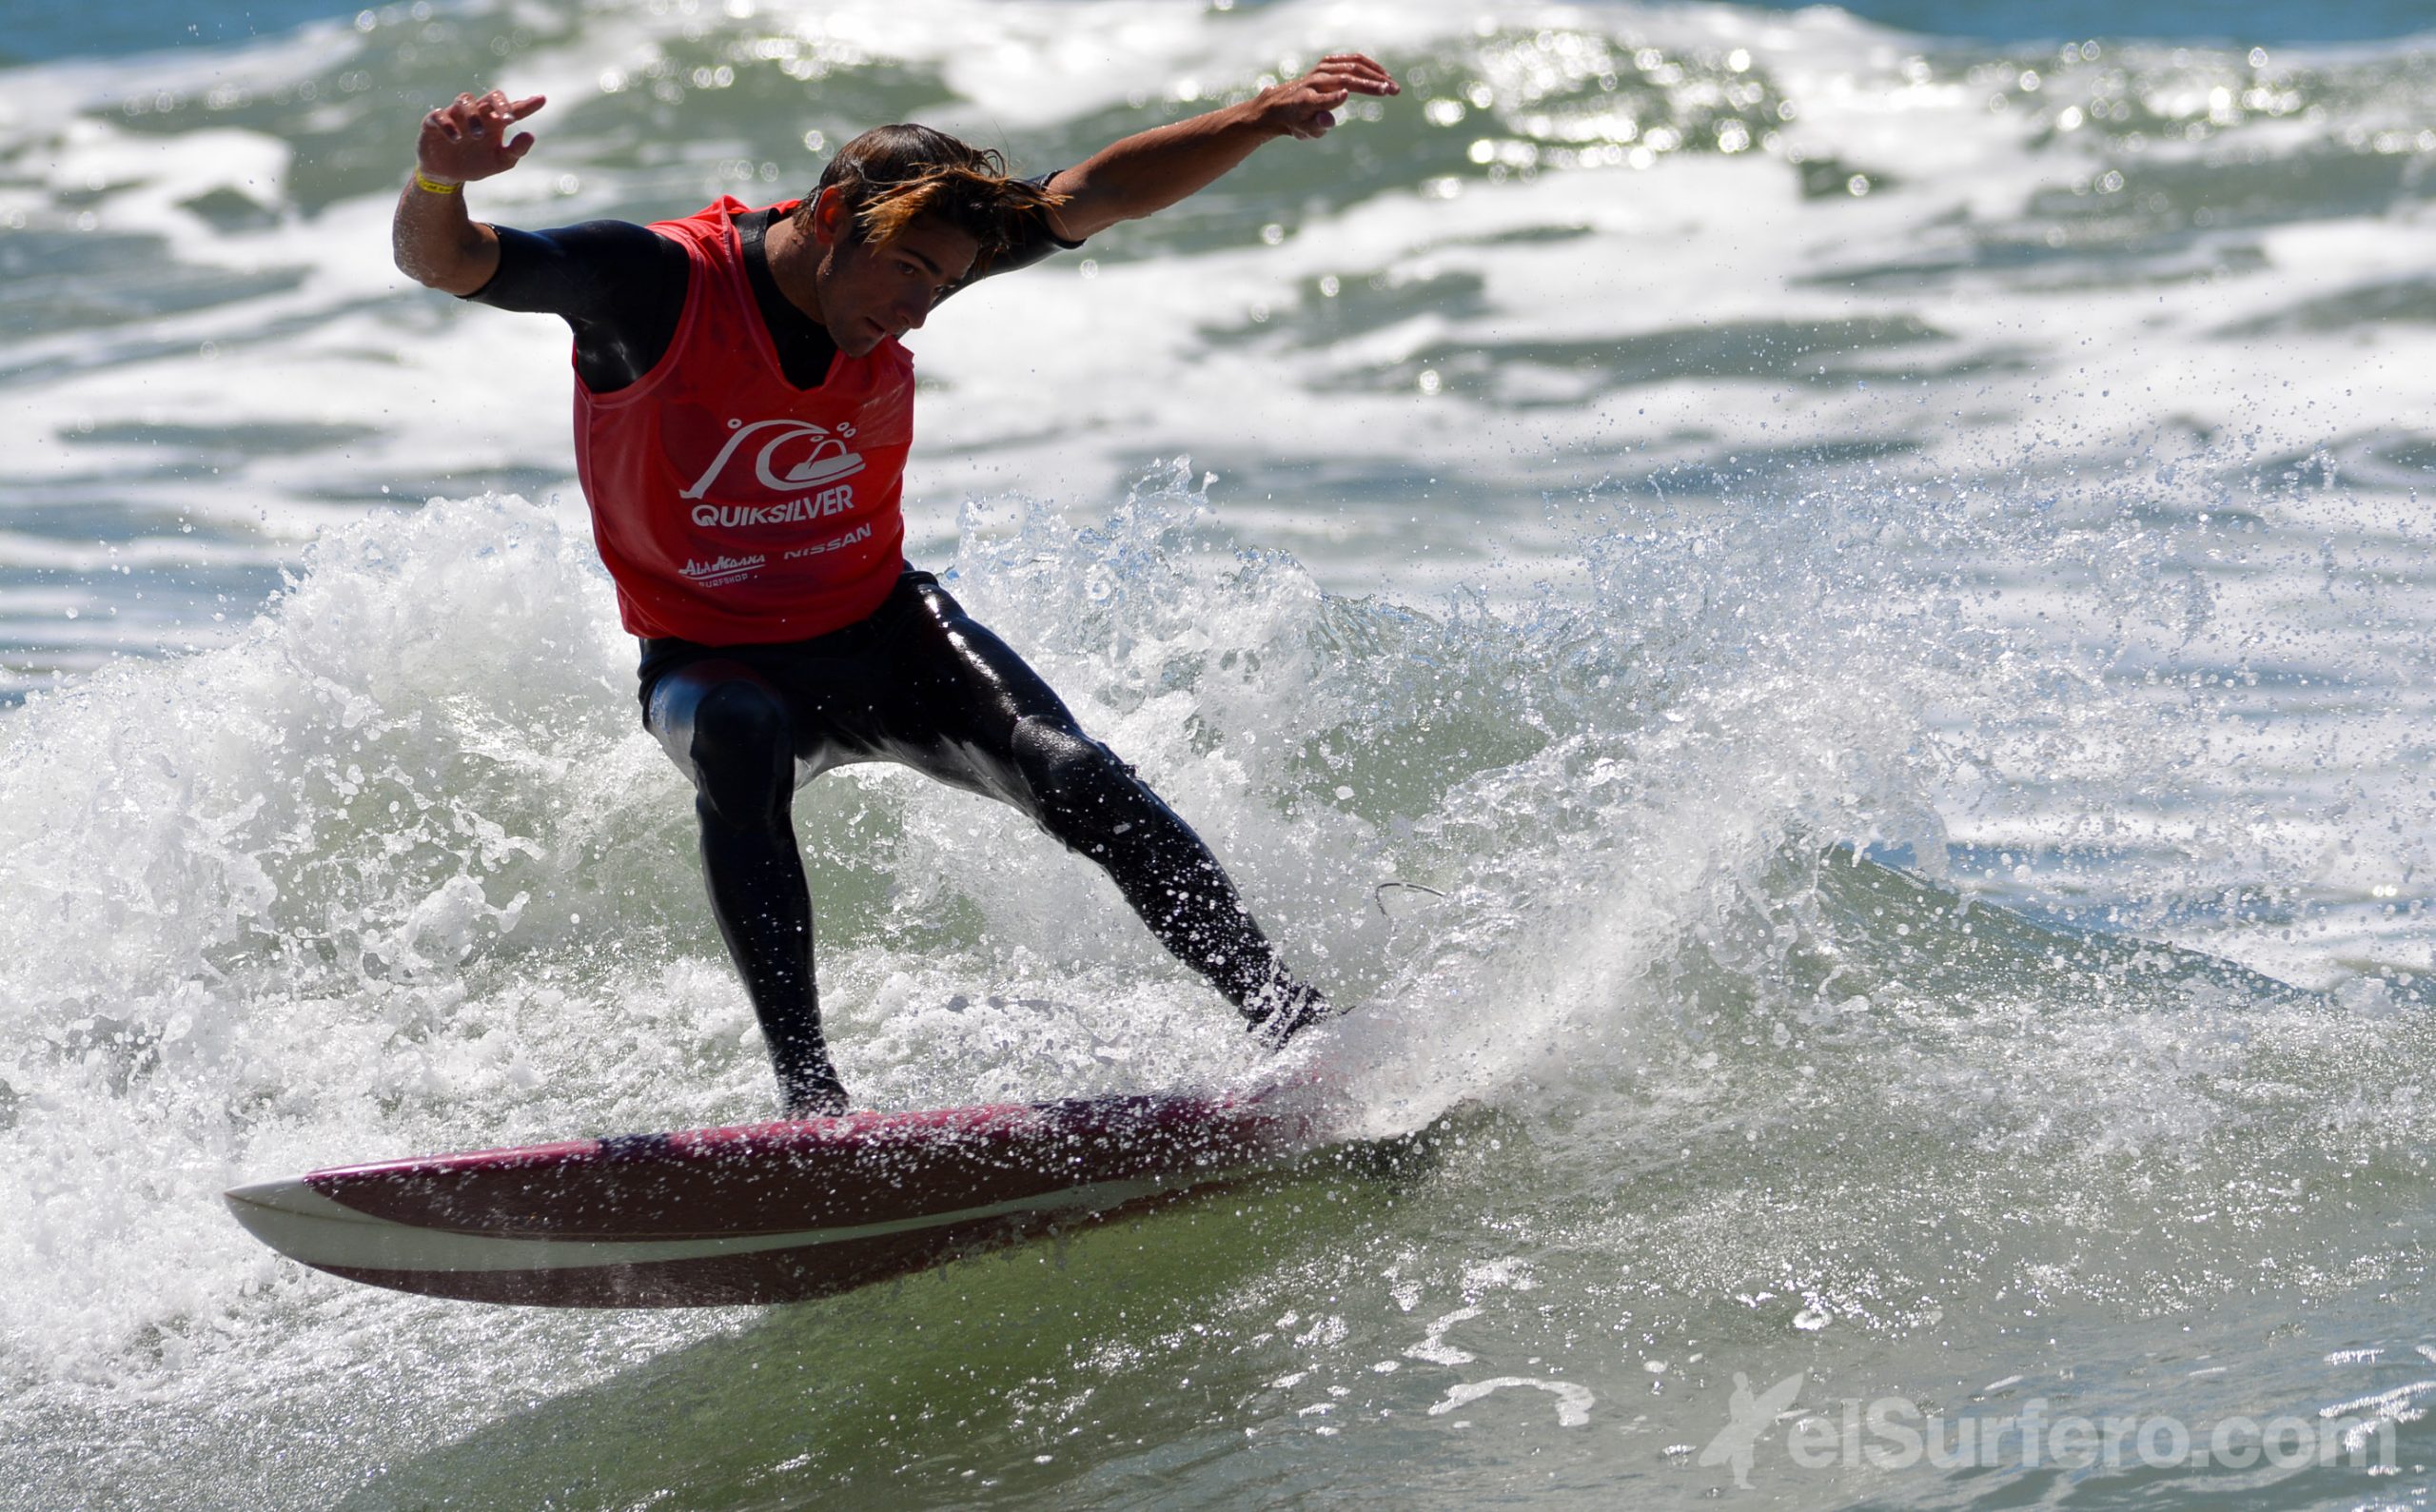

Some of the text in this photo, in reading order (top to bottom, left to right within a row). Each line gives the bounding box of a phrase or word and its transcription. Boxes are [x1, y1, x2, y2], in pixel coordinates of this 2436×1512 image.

[691, 484, 855, 528] QUIKSILVER
[783, 522, 873, 560] NISSAN
[698, 573, 749, 588] SURFSHOP
